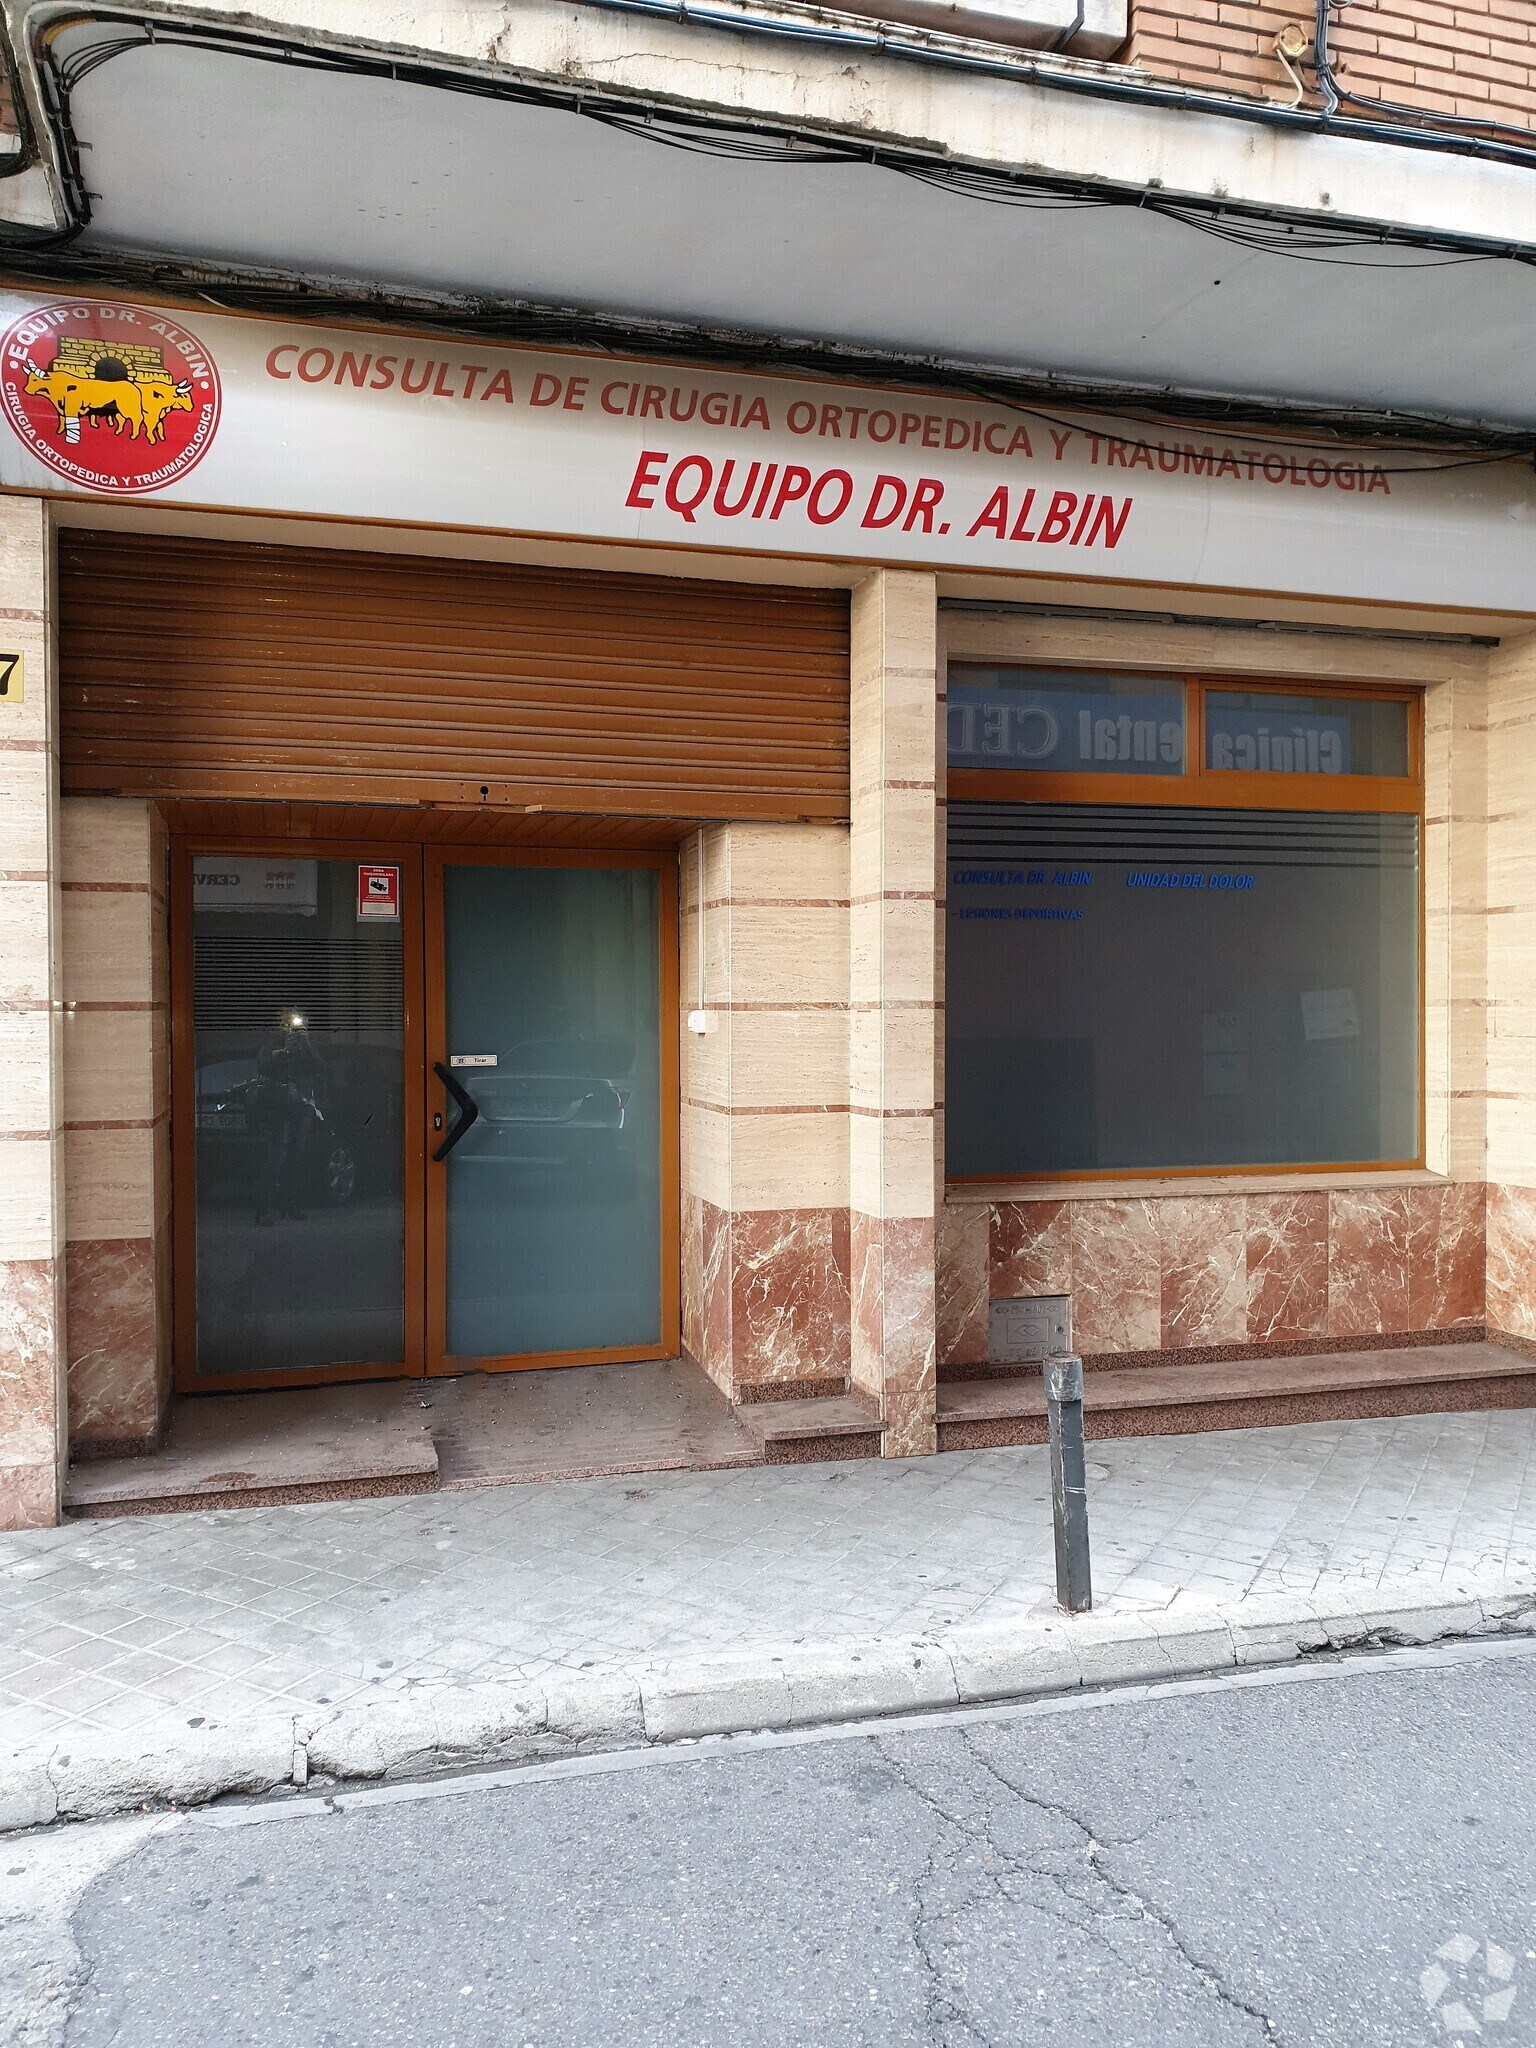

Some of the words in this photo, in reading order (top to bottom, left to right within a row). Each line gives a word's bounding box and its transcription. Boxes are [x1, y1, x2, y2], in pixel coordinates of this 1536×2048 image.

[7, 307, 91, 361] EQUIPO
[99, 306, 142, 326] DR.
[149, 322, 210, 379] ALBIN
[5, 381, 37, 439] CIRUGIA
[35, 439, 119, 486] ORTOPEDICA
[121, 476, 131, 487] Y
[134, 402, 213, 486] TRAUMATOLOGICA
[265, 343, 515, 405] CONSULTA
[528, 372, 591, 412] DE
[600, 380, 772, 432] CIRUGIA
[785, 400, 1034, 459] ORTOPEDICA
[1049, 428, 1073, 461] Y
[1084, 432, 1392, 495] TRAUMATOLOGIA
[624, 450, 855, 525] EQUIPO
[859, 474, 952, 536] DR.
[965, 484, 1134, 550] ALBIN
[953, 870, 1024, 886] CONSULTA
[1052, 870, 1093, 886] ALBIN
[1127, 871, 1180, 888] UNIDAD
[1181, 872, 1206, 889] DEL
[1208, 872, 1255, 889] DOLOR
